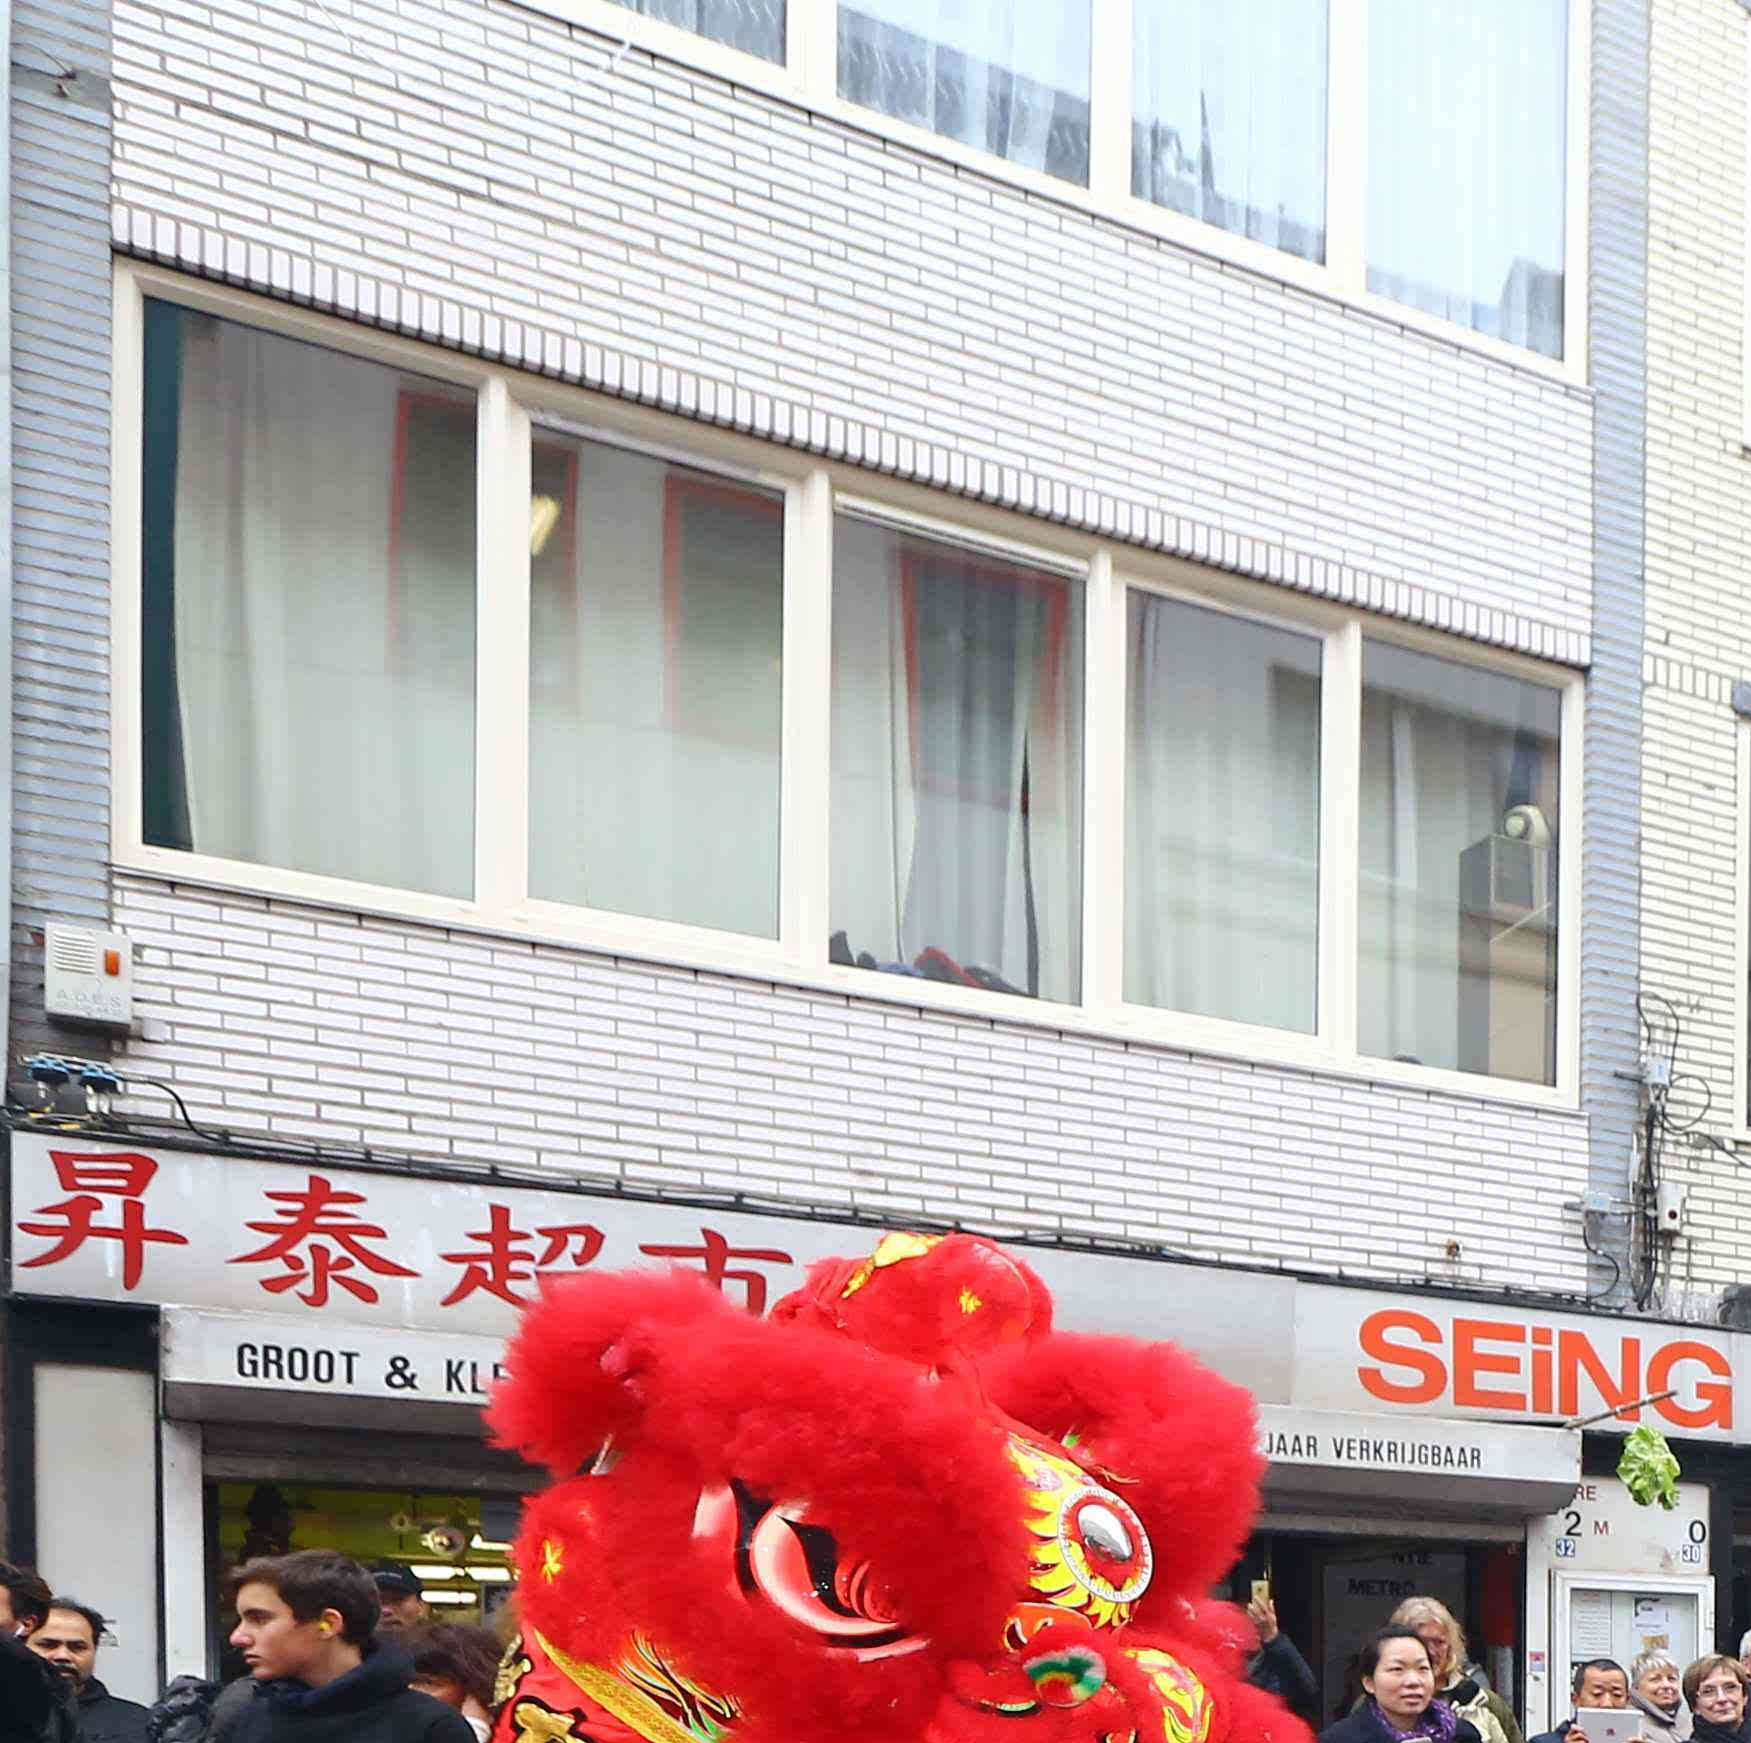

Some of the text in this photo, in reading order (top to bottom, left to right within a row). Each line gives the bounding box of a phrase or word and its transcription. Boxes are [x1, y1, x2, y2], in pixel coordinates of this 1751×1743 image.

[237, 1342, 360, 1385] GROOT
[384, 1356, 420, 1391] &
[1266, 1432, 1482, 1469] JAAR VERKRIJGBAAR
[1556, 1539, 1576, 1557] 32
[1682, 1545, 1701, 1563] 30
